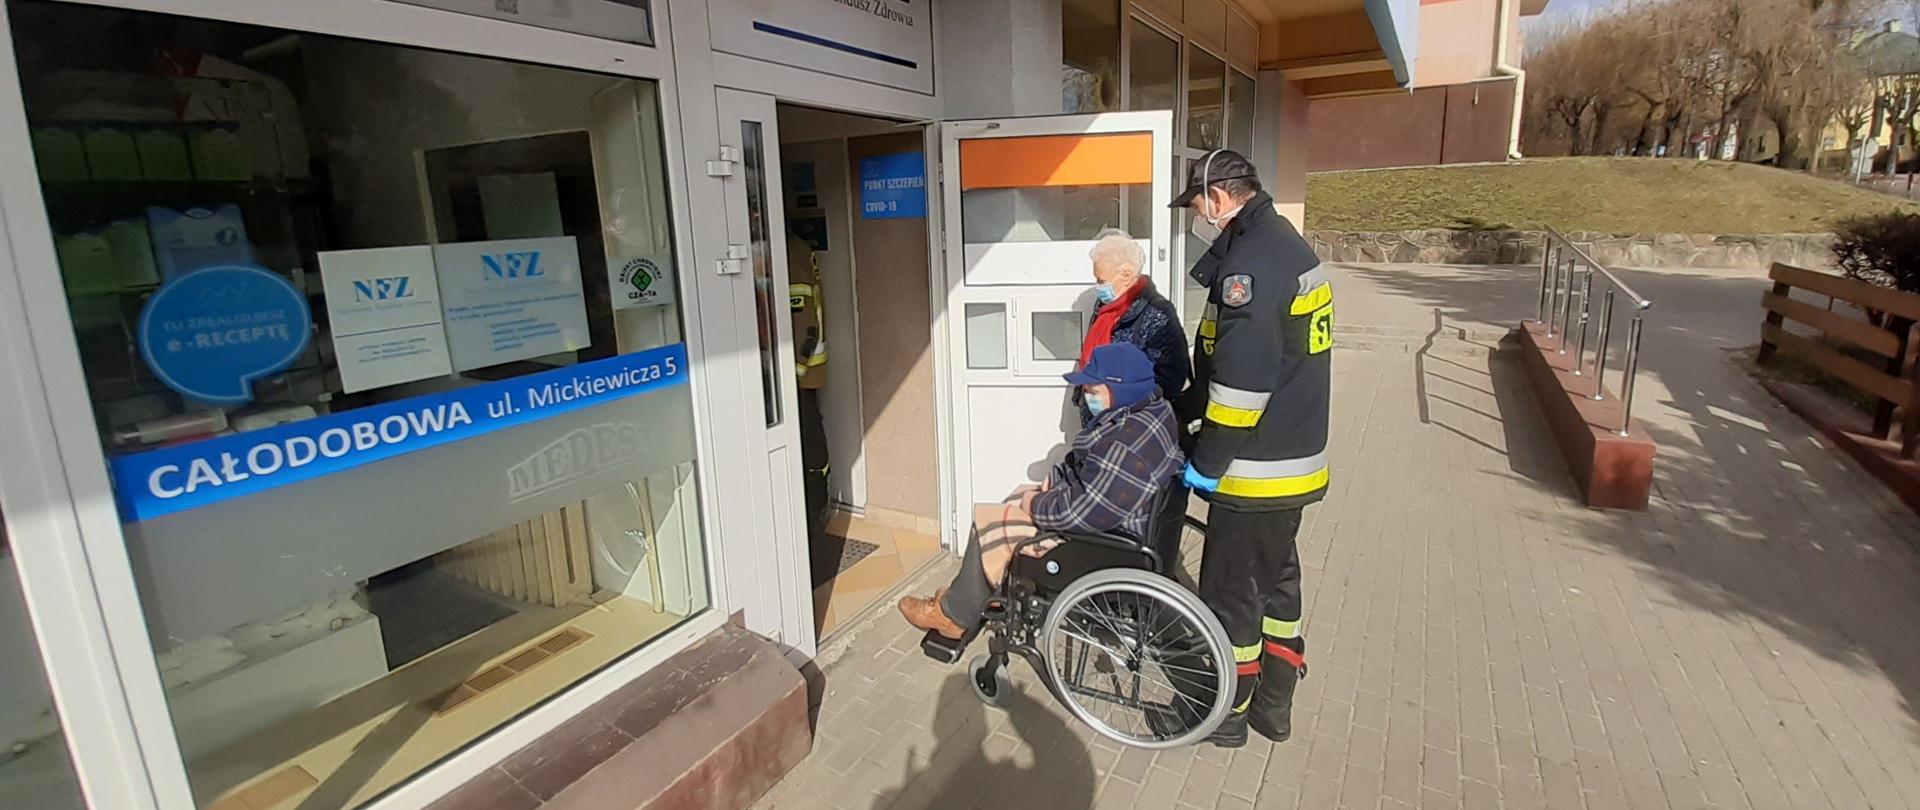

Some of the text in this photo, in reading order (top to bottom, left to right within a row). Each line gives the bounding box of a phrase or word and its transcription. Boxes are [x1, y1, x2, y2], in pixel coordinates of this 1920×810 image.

[874, 0, 914, 27] Zdrowia
[864, 175, 924, 191] PUNKT SZCZEPIEŃ
[865, 201, 897, 212] COVID-19
[480, 251, 544, 281] NFZ
[352, 275, 414, 303] NFZ
[148, 356, 677, 498] CAŁODOBOWA ul. Mickiewicza 5
